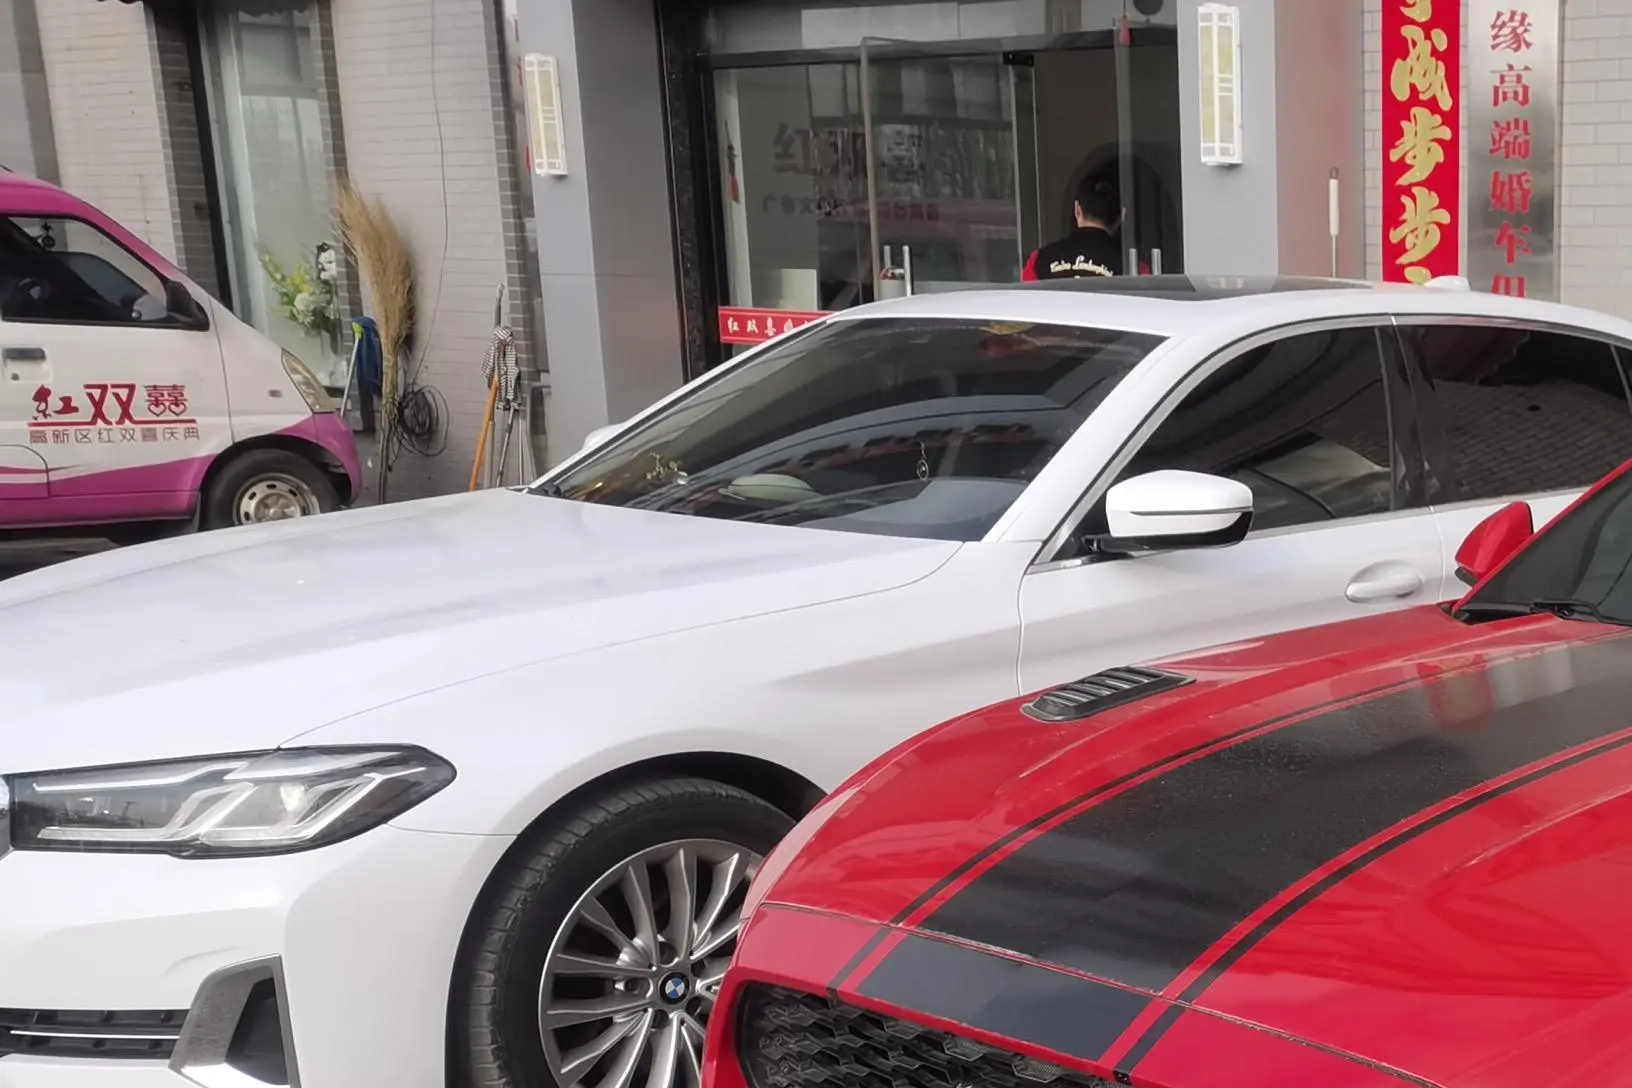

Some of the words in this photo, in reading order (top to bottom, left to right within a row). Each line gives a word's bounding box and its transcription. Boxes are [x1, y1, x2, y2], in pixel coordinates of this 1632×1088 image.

[1389, 0, 1453, 285] 成步步
[727, 316, 809, 337] 红双喜
[29, 426, 201, 444] 高新区红双喜庆典
